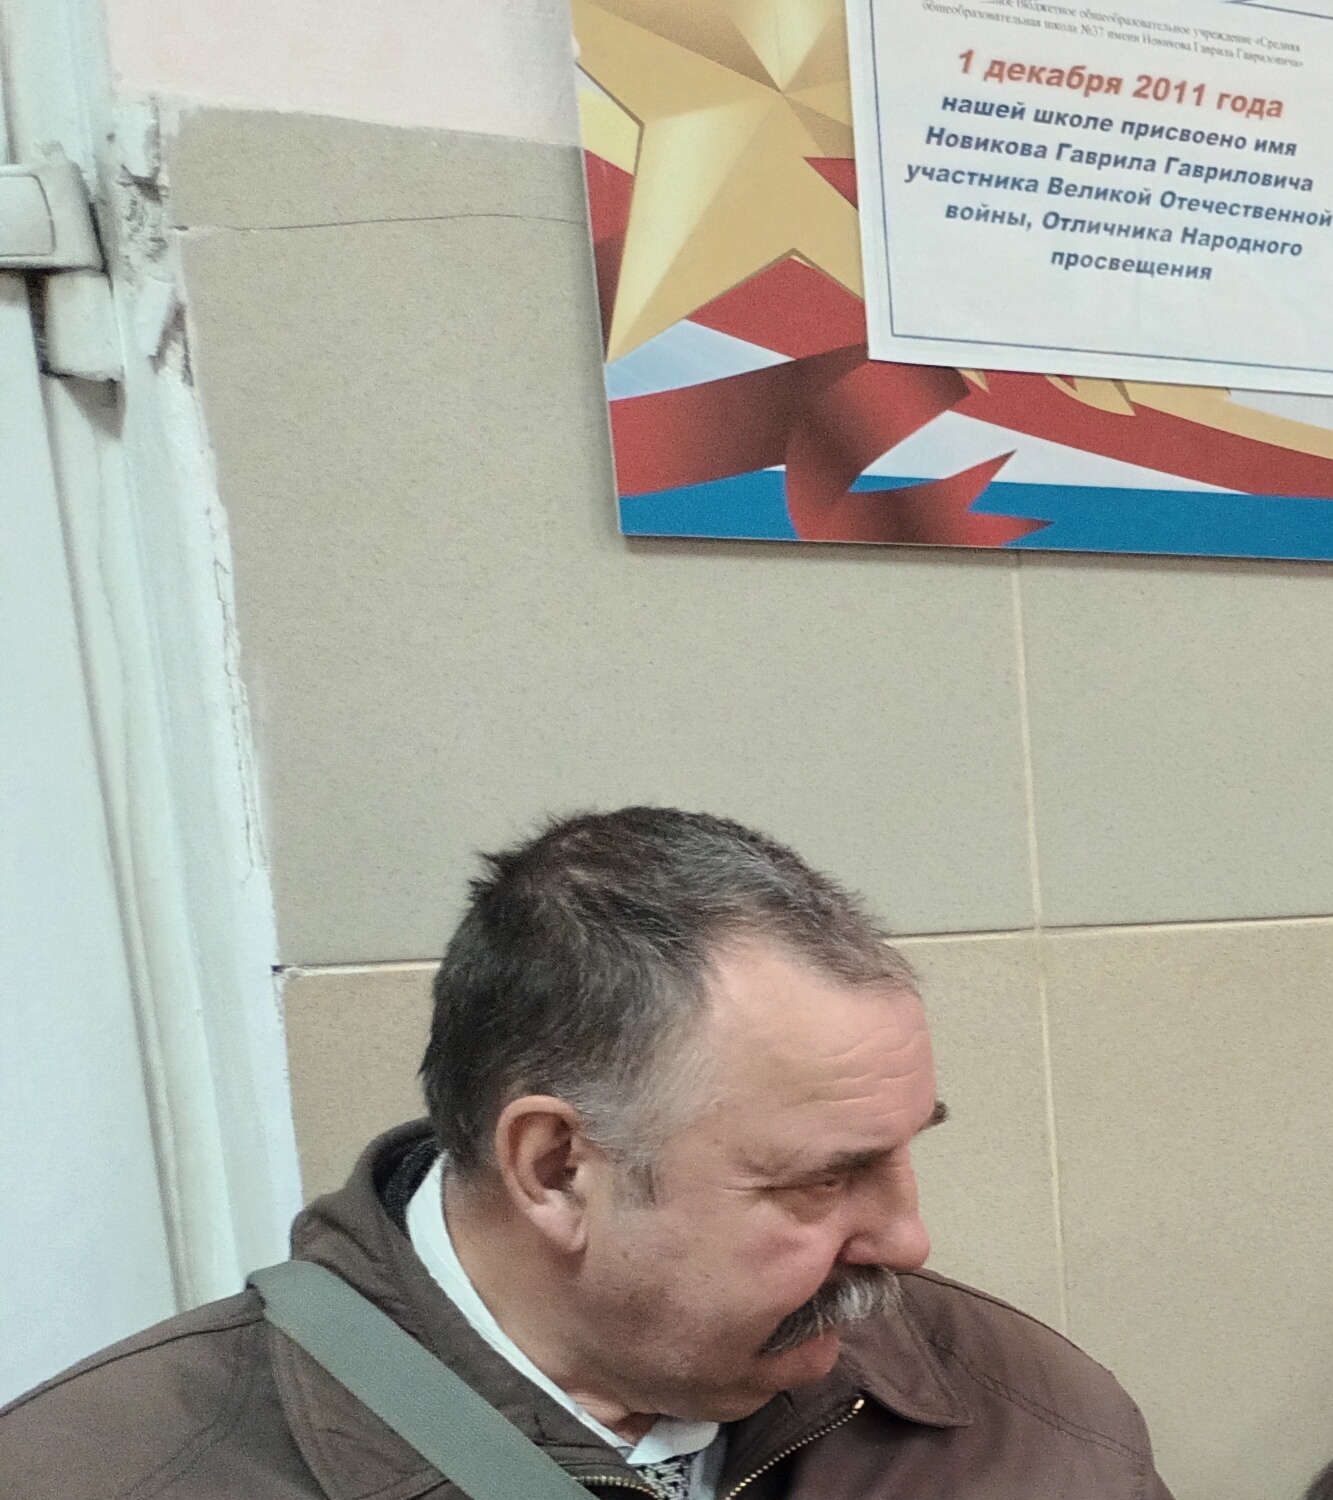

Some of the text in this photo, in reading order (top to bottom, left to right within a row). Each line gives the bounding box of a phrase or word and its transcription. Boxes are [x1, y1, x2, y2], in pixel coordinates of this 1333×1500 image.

[922, 1, 1041, 27] общеобразовательная
[1044, 20, 1078, 33] школа
[1107, 31, 1140, 43] имени
[1142, 34, 1192, 51] Новикова
[959, 49, 1284, 120] 1 декабря 2011 года
[941, 96, 1298, 156] нашей школе присвоено имя
[925, 126, 1314, 192] Новикова Гаврила Гавриловича
[904, 164, 1333, 227] участника Великой Отечественной
[944, 203, 1304, 257] войны, Отличника Народного
[1050, 251, 1213, 280] просвещения
